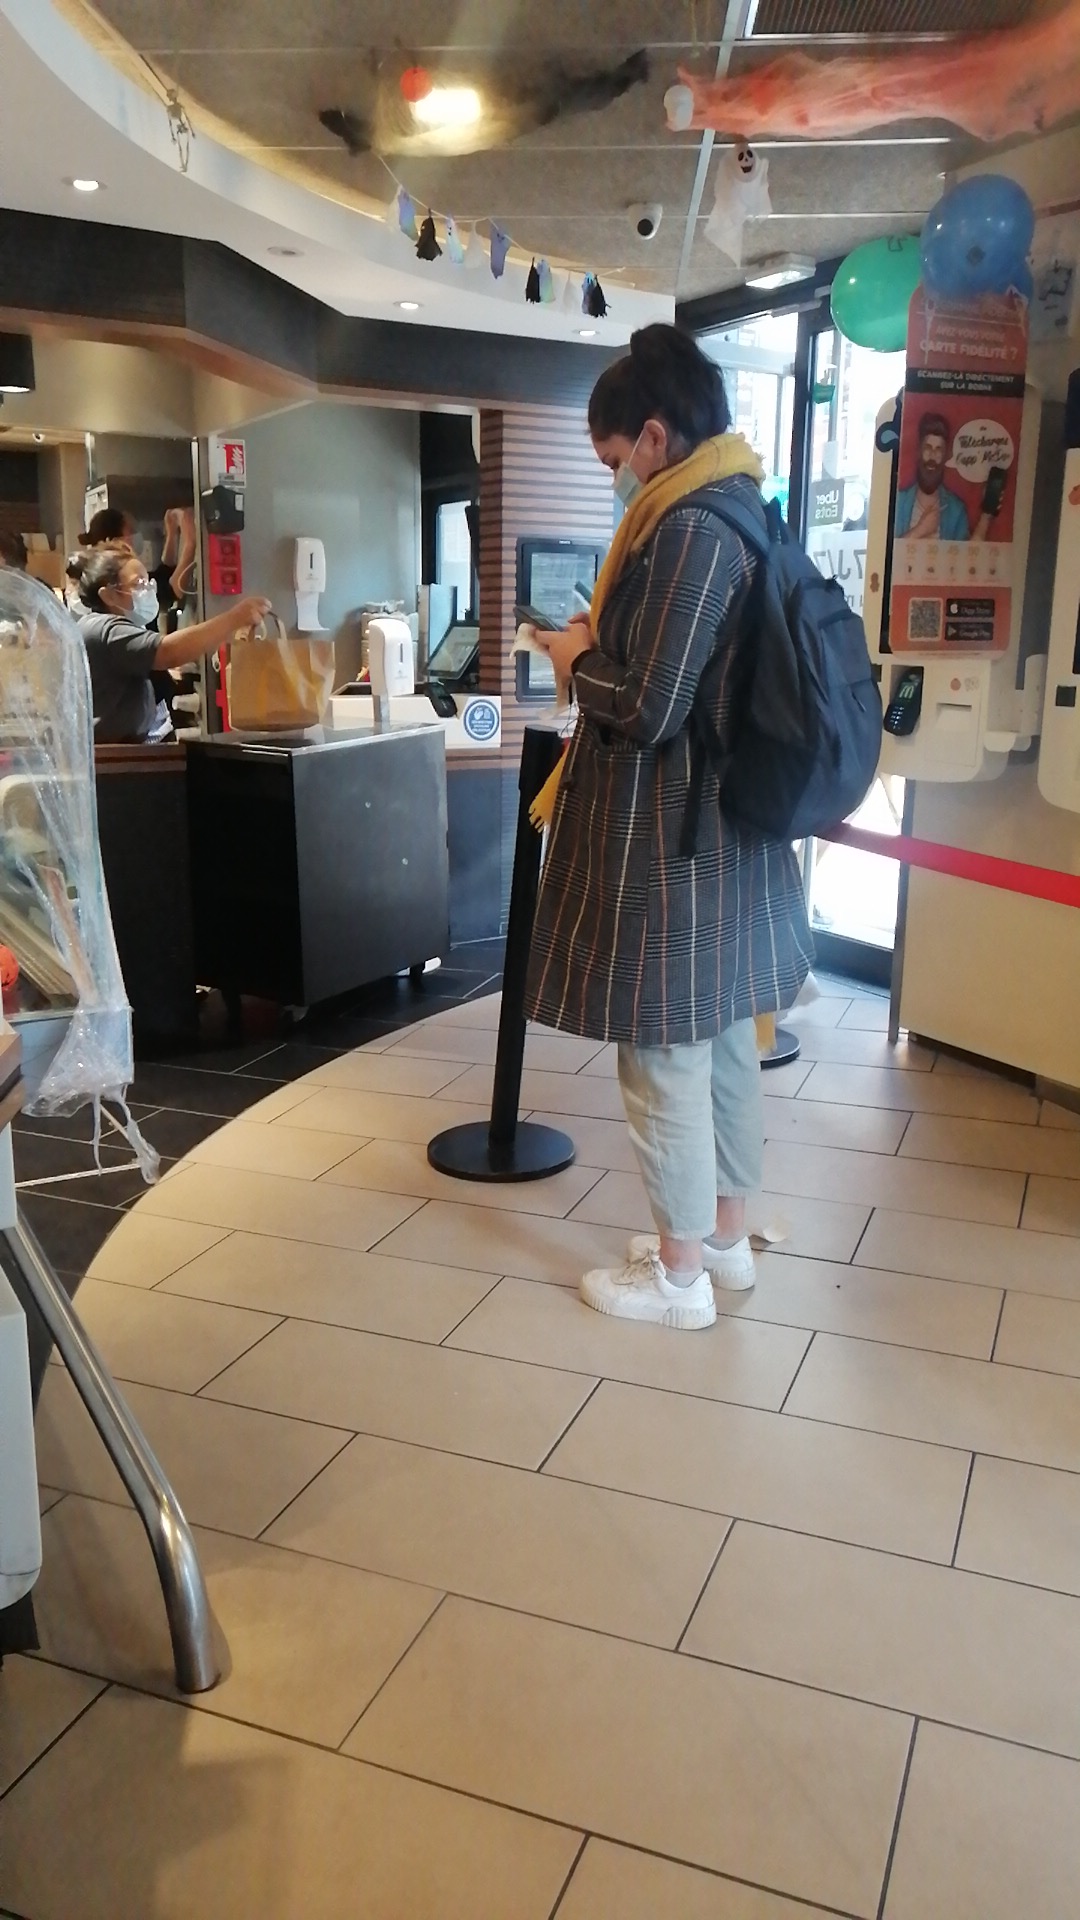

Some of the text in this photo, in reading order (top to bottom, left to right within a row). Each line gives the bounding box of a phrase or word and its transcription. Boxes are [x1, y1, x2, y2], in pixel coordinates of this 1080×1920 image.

[920, 340, 1019, 360] CARTE FIDÉLITÉ ?
